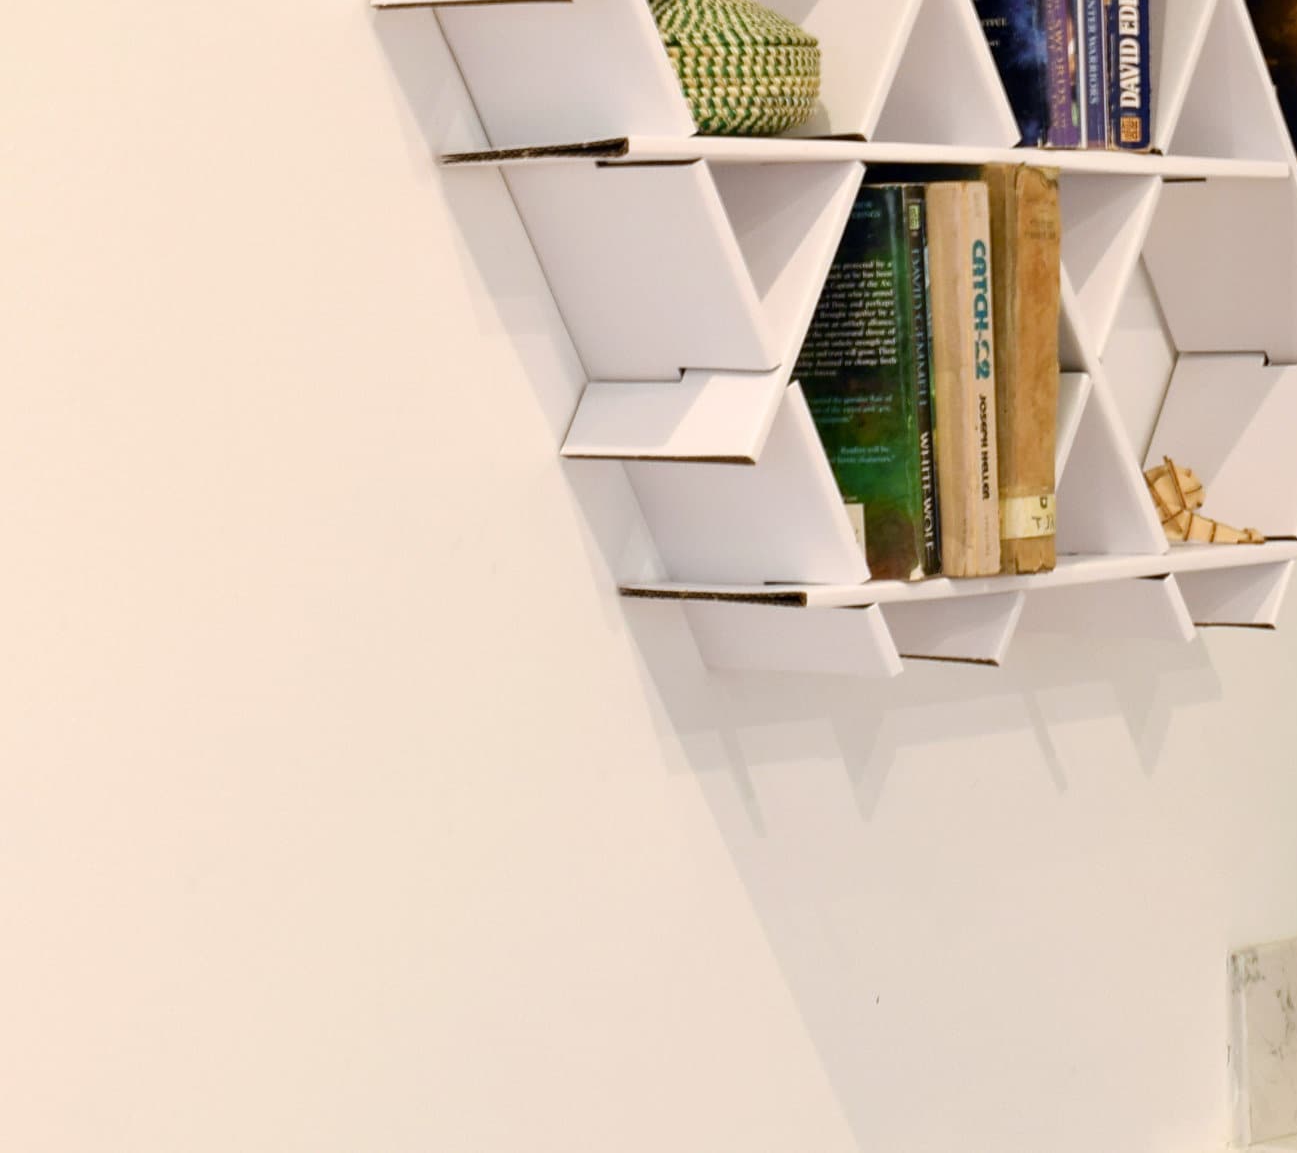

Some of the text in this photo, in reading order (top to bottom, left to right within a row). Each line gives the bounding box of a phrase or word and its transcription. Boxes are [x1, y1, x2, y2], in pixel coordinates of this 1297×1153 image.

[1088, 36, 1101, 106] WARRIORS
[1118, 38, 1142, 109] DAVID
[911, 248, 924, 311] DAVID
[972, 239, 991, 381] CATCH-22
[979, 394, 991, 501] JOSEPH HELLER
[921, 496, 936, 552] WOLF
